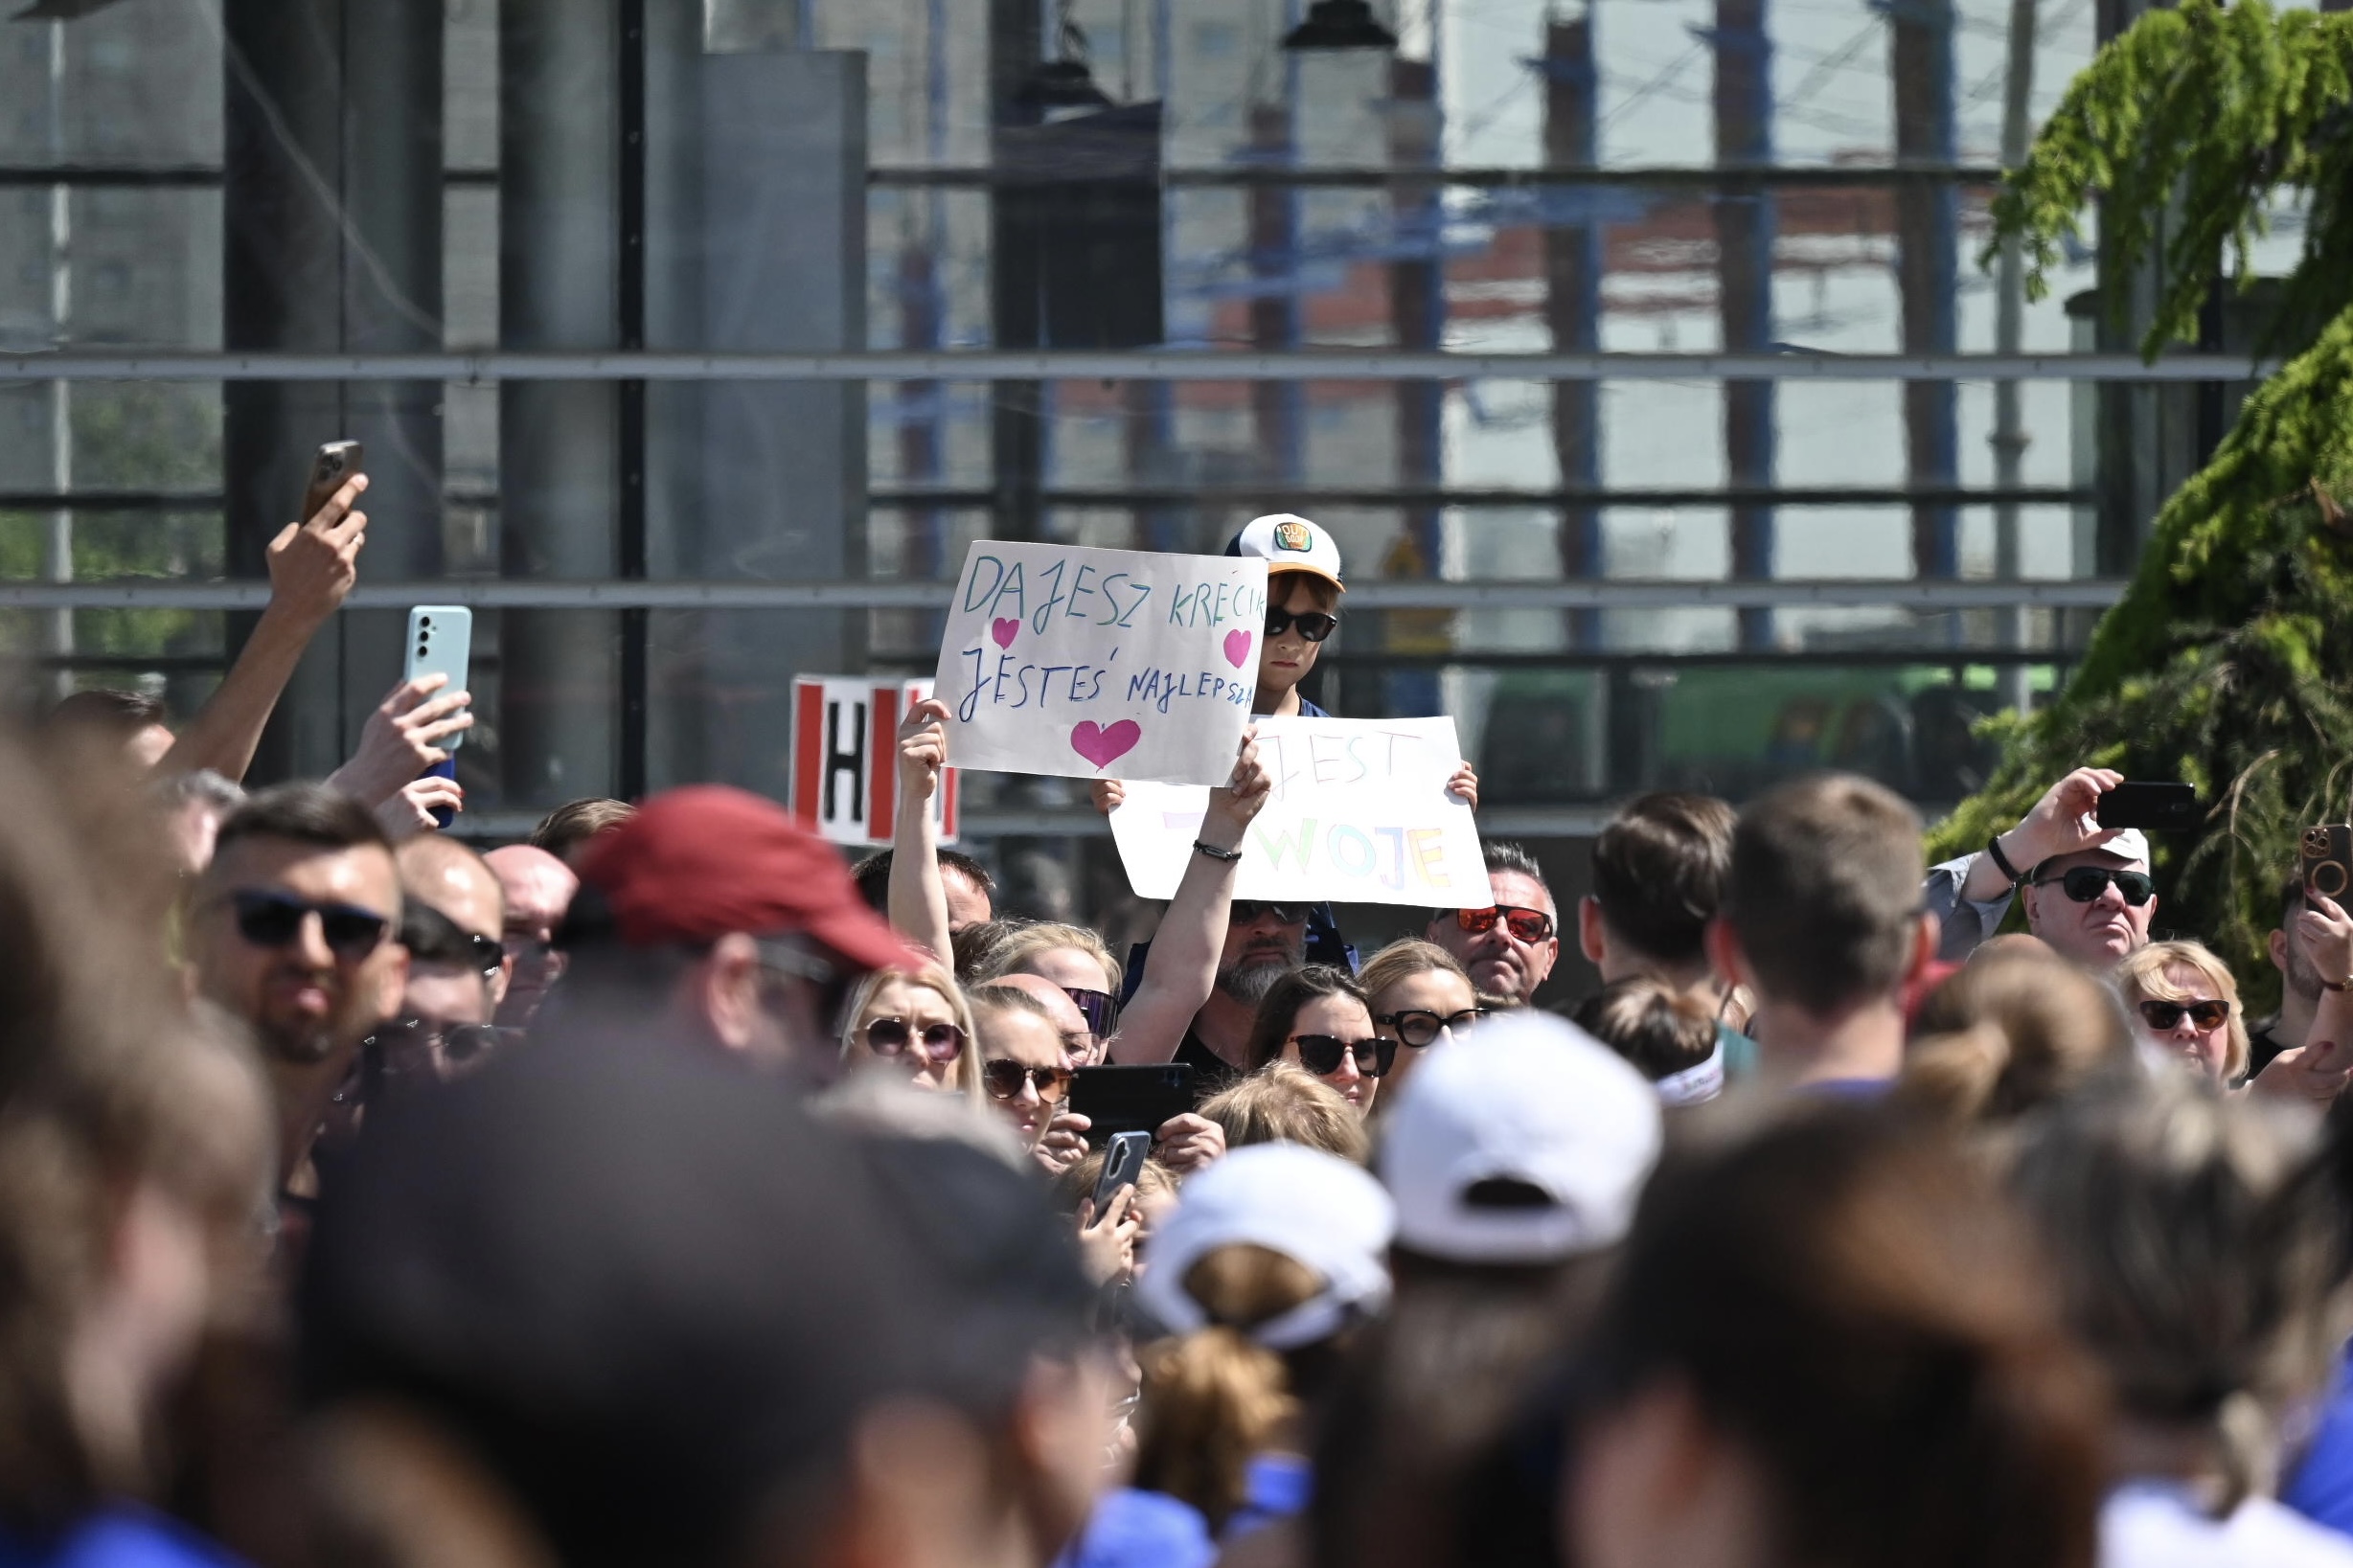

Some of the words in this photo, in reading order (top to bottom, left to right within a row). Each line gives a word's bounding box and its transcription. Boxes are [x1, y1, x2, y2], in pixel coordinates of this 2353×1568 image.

[964, 556, 1151, 635] DAJESZ
[959, 647, 1118, 723] JESTEŚ
[1254, 730, 1423, 803] JEST
